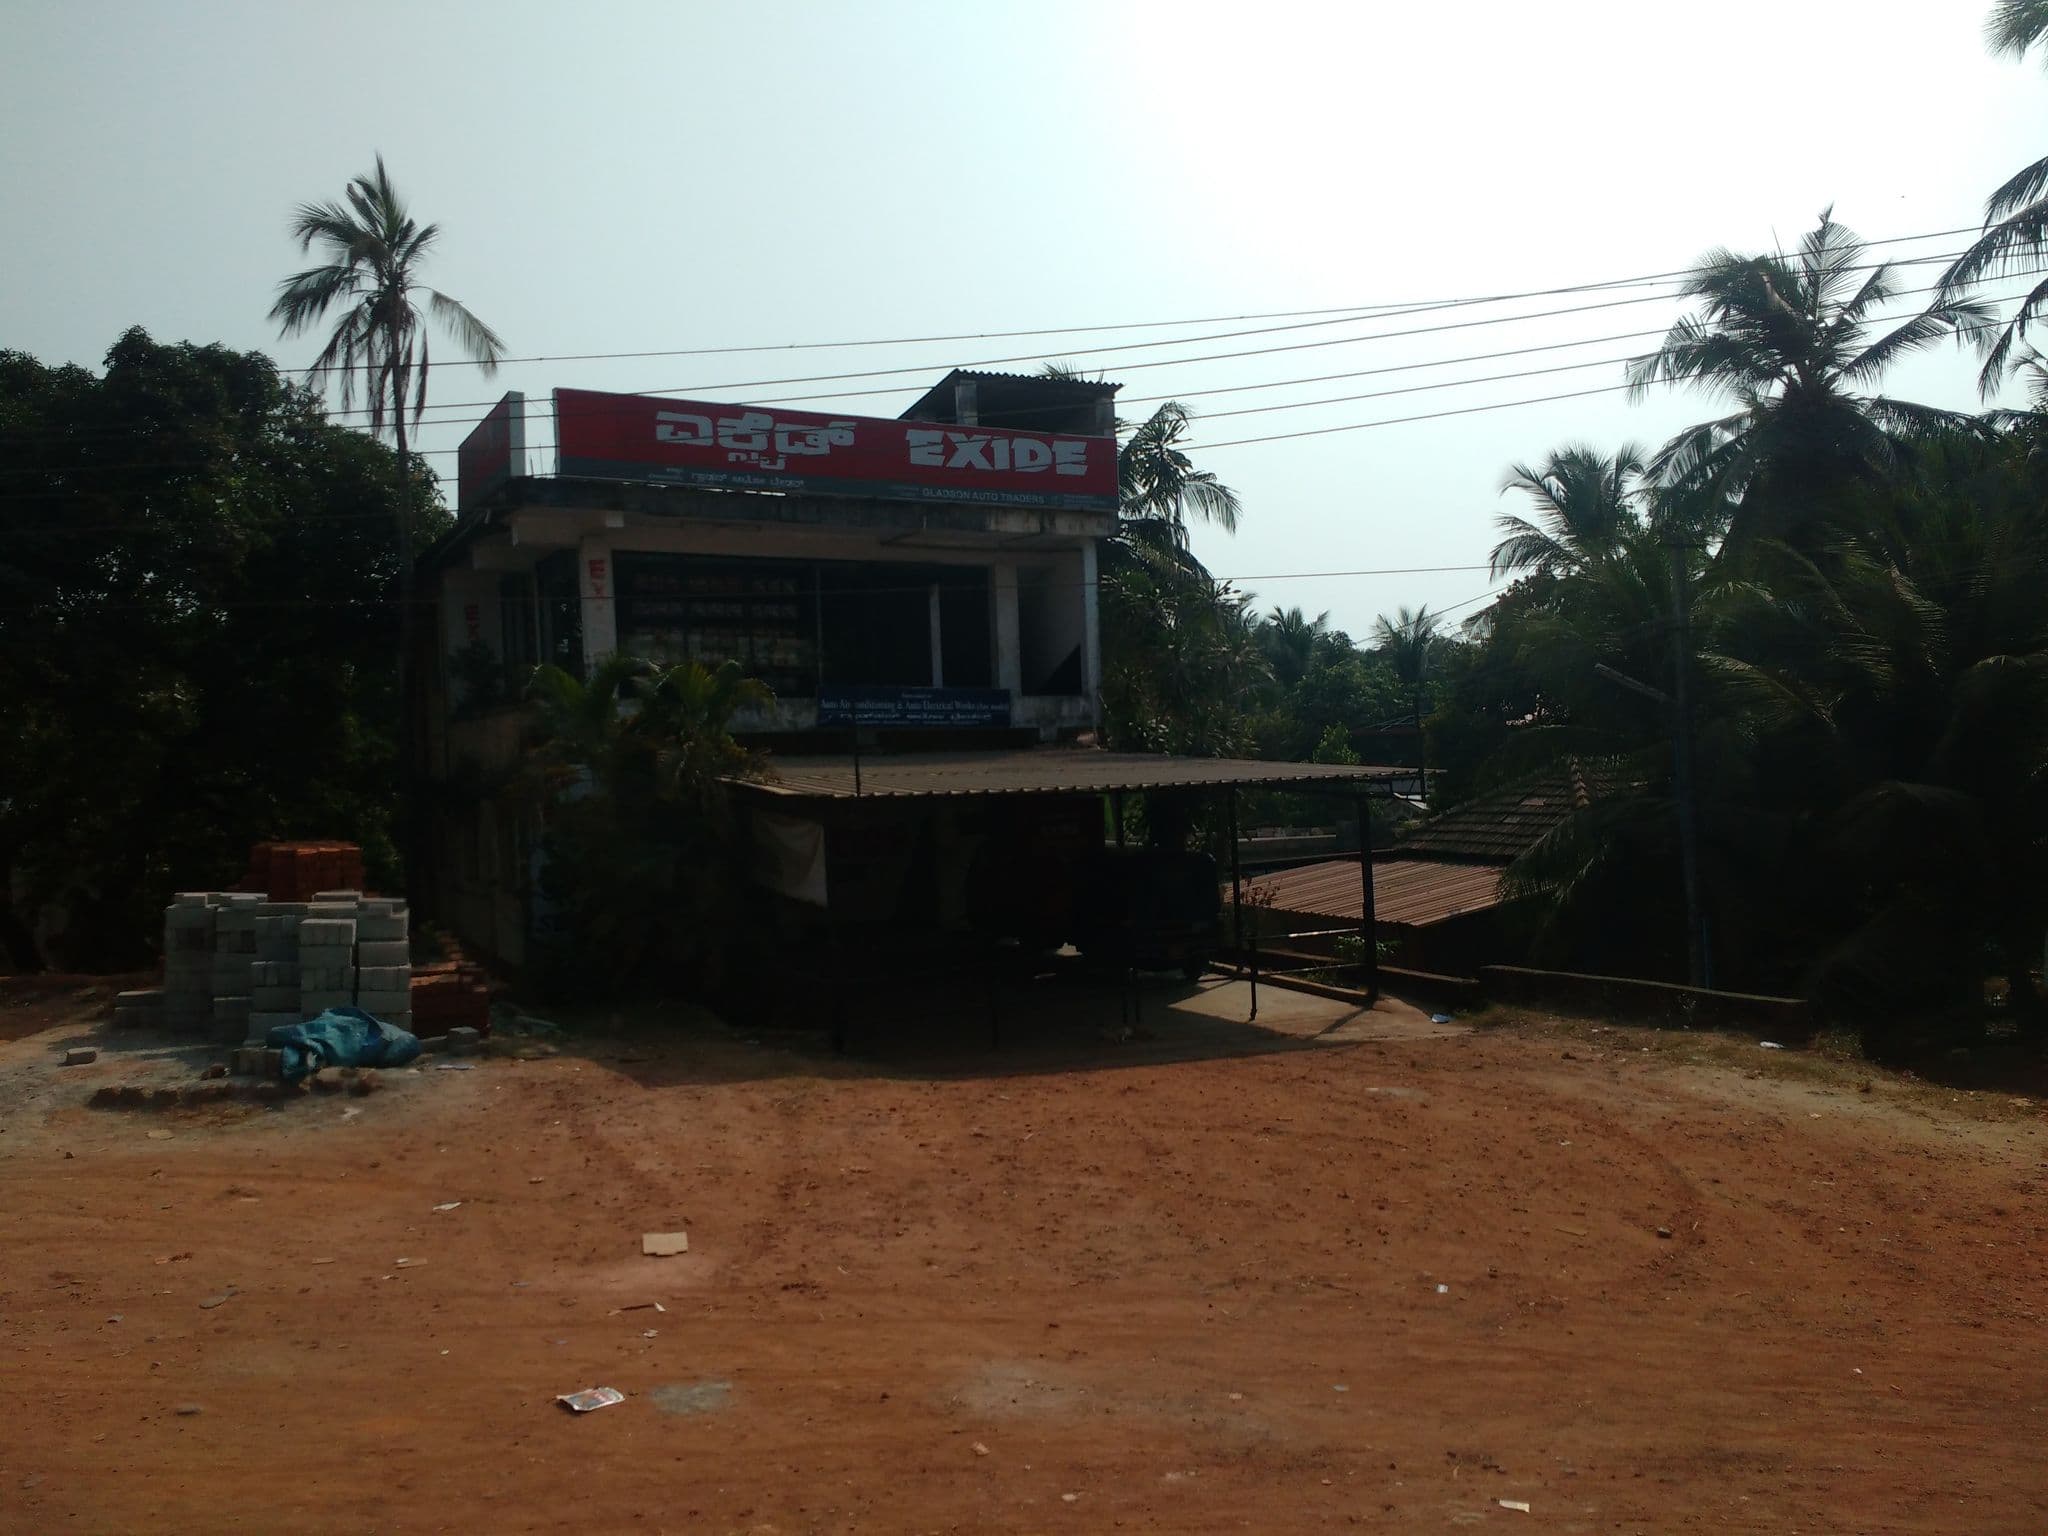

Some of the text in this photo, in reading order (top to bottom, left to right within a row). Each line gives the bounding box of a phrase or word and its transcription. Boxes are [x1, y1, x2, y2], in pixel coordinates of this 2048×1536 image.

[906, 429, 1088, 476] EXIDE
[922, 487, 971, 499] GLADSON
[973, 491, 998, 501] AUTO
[1000, 493, 1045, 504] TRADERS
